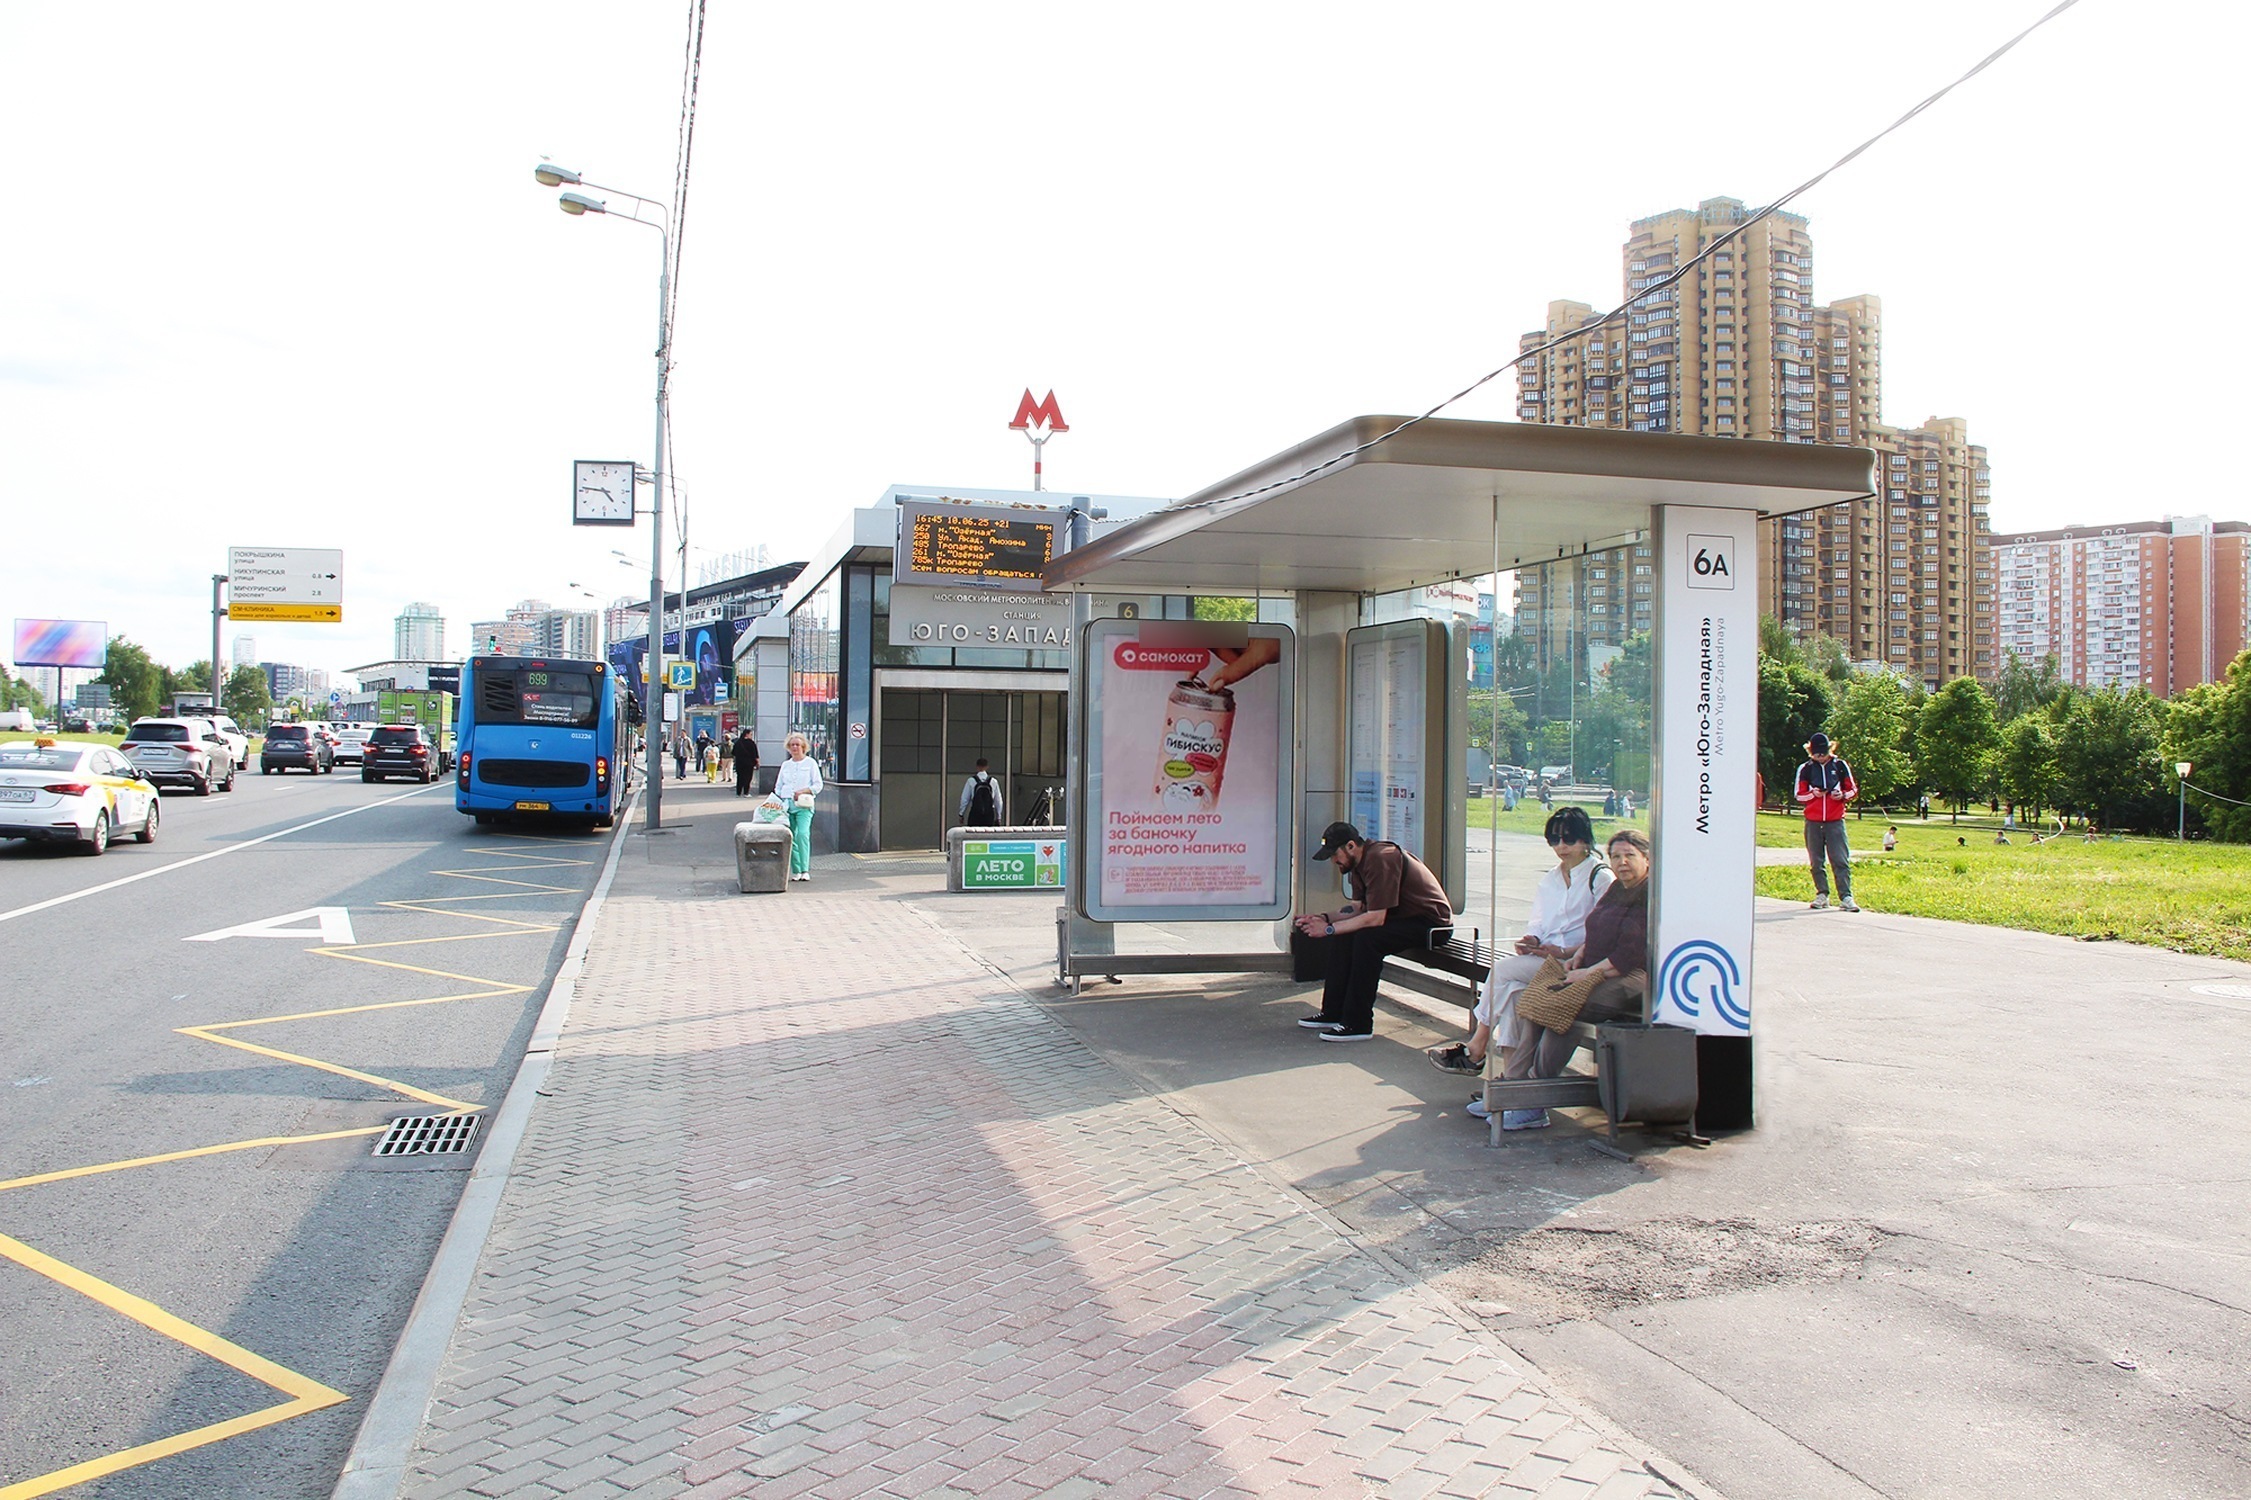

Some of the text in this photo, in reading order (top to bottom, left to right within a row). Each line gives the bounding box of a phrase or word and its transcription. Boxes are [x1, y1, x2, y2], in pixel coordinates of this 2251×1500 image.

[1009, 387, 1069, 431] М
[914, 523, 931, 532] 667
[915, 514, 943, 524] 16:45
[947, 516, 989, 527] 10.06.25
[994, 520, 1010, 528] +21
[913, 532, 931, 541] 250
[958, 535, 984, 544] Акад.
[989, 537, 1027, 547] Анохина
[1045, 541, 1052, 549] 6
[938, 542, 985, 552] Тропарево
[912, 548, 927, 557] 261
[936, 557, 984, 568] Тропарево
[936, 566, 979, 575] вопросам
[982, 569, 1035, 579] обращаться
[933, 592, 989, 603] МОСКОВСКИЙ
[1002, 610, 1042, 621] СТАНЦИЯ
[1123, 605, 1133, 619] 6
[1138, 651, 1204, 663] самокат
[528, 672, 548, 686] 699
[1714, 617, 1726, 756] Metro Yugo-Zapadnaya
[1696, 617, 1712, 834] Метро «Юго-Западная»
[1166, 737, 1222, 753] ГИБИСКУС
[1109, 810, 1222, 825] Поймаем лето
[1108, 826, 1197, 842] за баночку
[1107, 842, 1246, 856] ягодного напитка
[976, 859, 1025, 873] ЛЕТО
